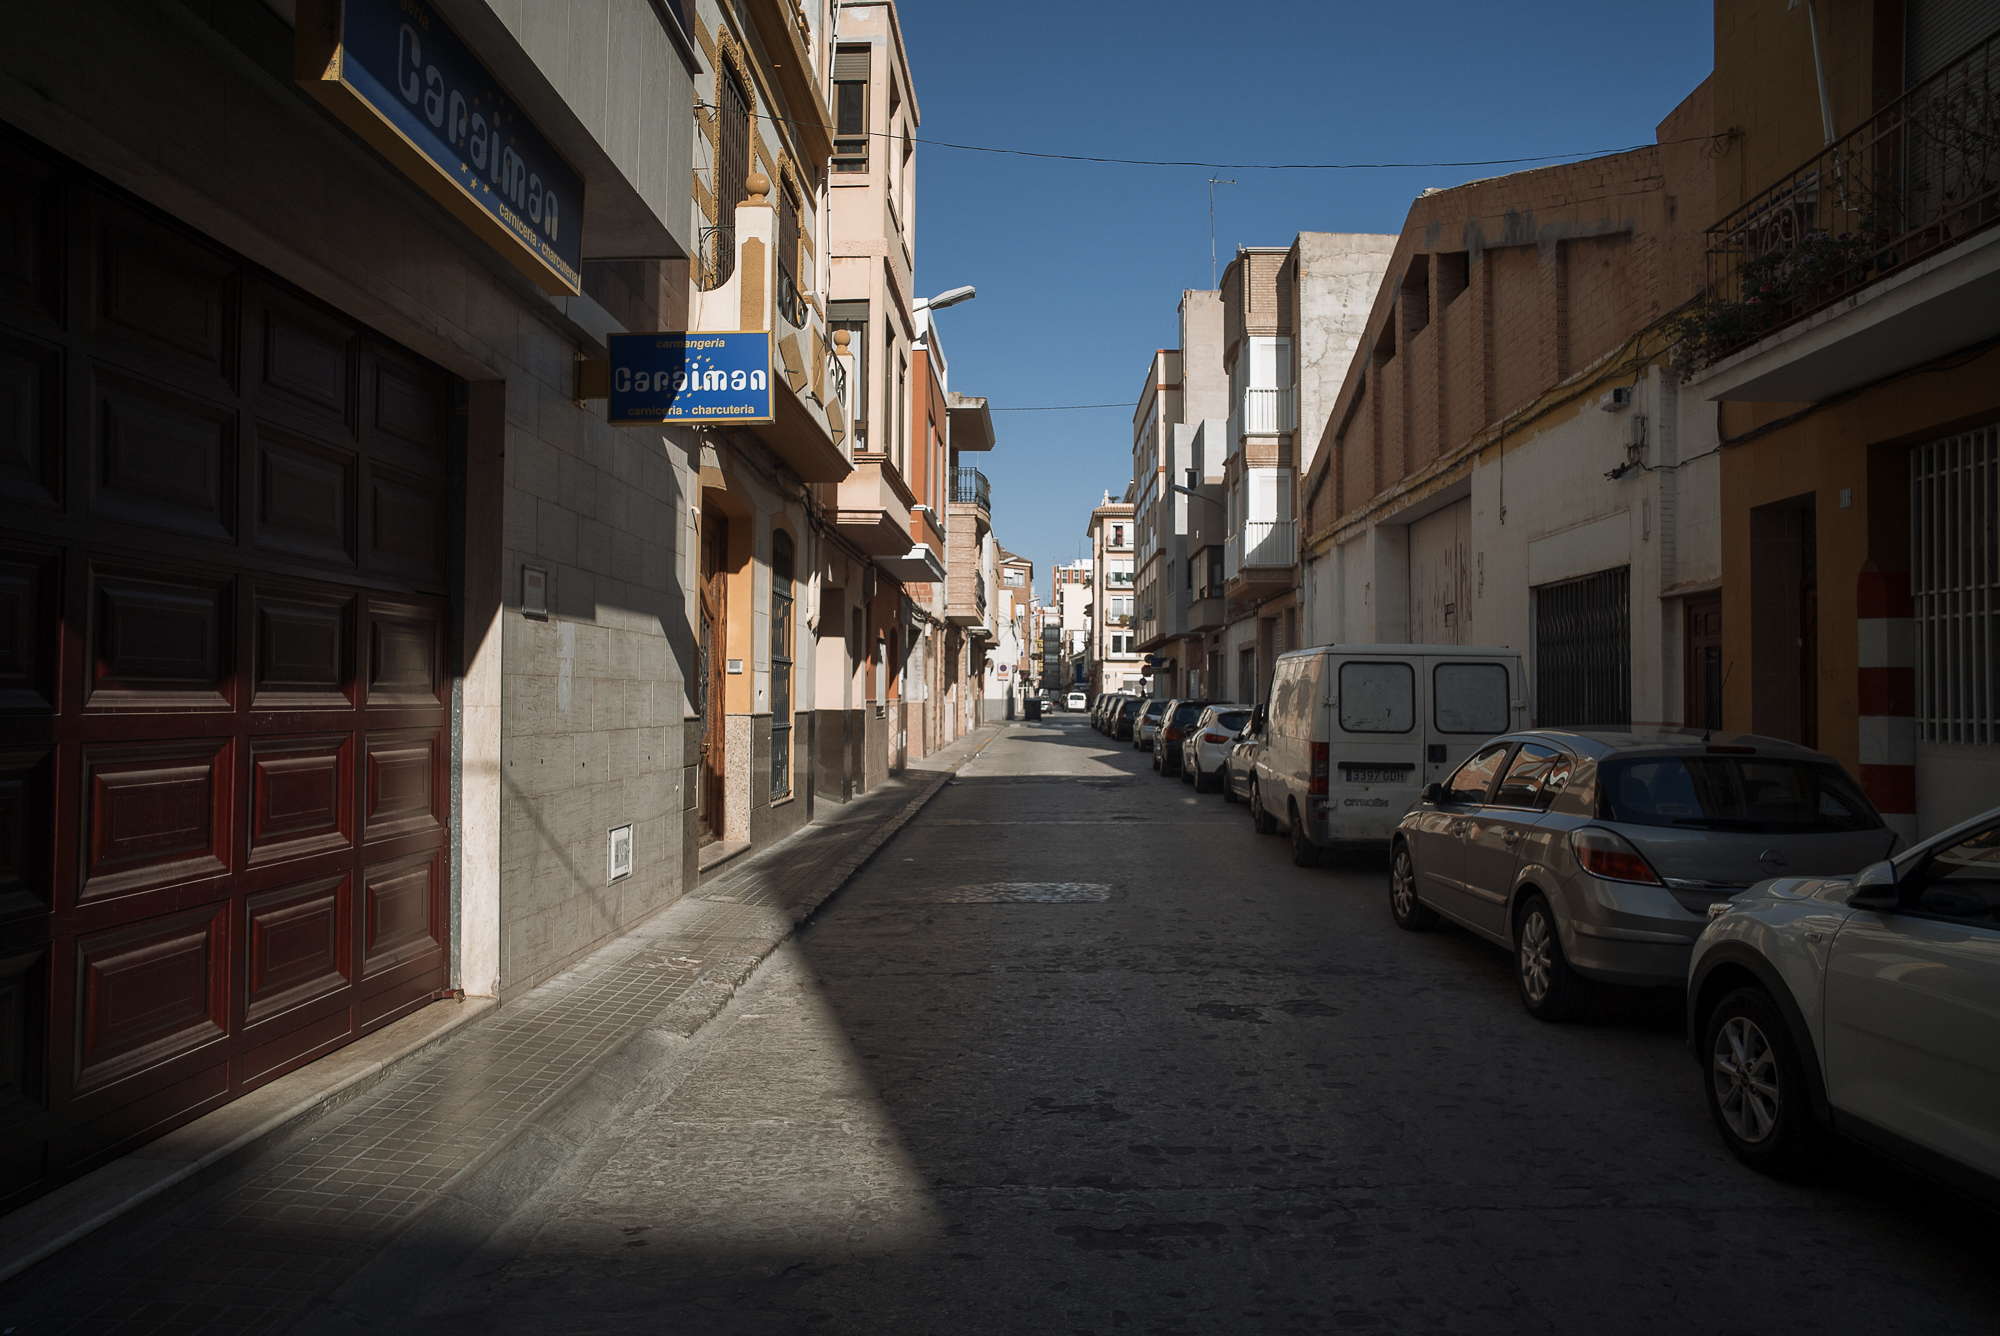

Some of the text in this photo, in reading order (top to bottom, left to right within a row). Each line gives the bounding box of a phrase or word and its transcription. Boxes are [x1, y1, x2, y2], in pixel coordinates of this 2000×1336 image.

[398, 22, 559, 242] Caraiman
[499, 203, 578, 285] carniceria charcuteria
[656, 338, 726, 350] carmangeria
[615, 362, 767, 393] Caraiman
[627, 404, 755, 416] carniceria charcuteria
[1353, 770, 1404, 781] 3397 GDH
[1344, 798, 1389, 807] CITROËN
